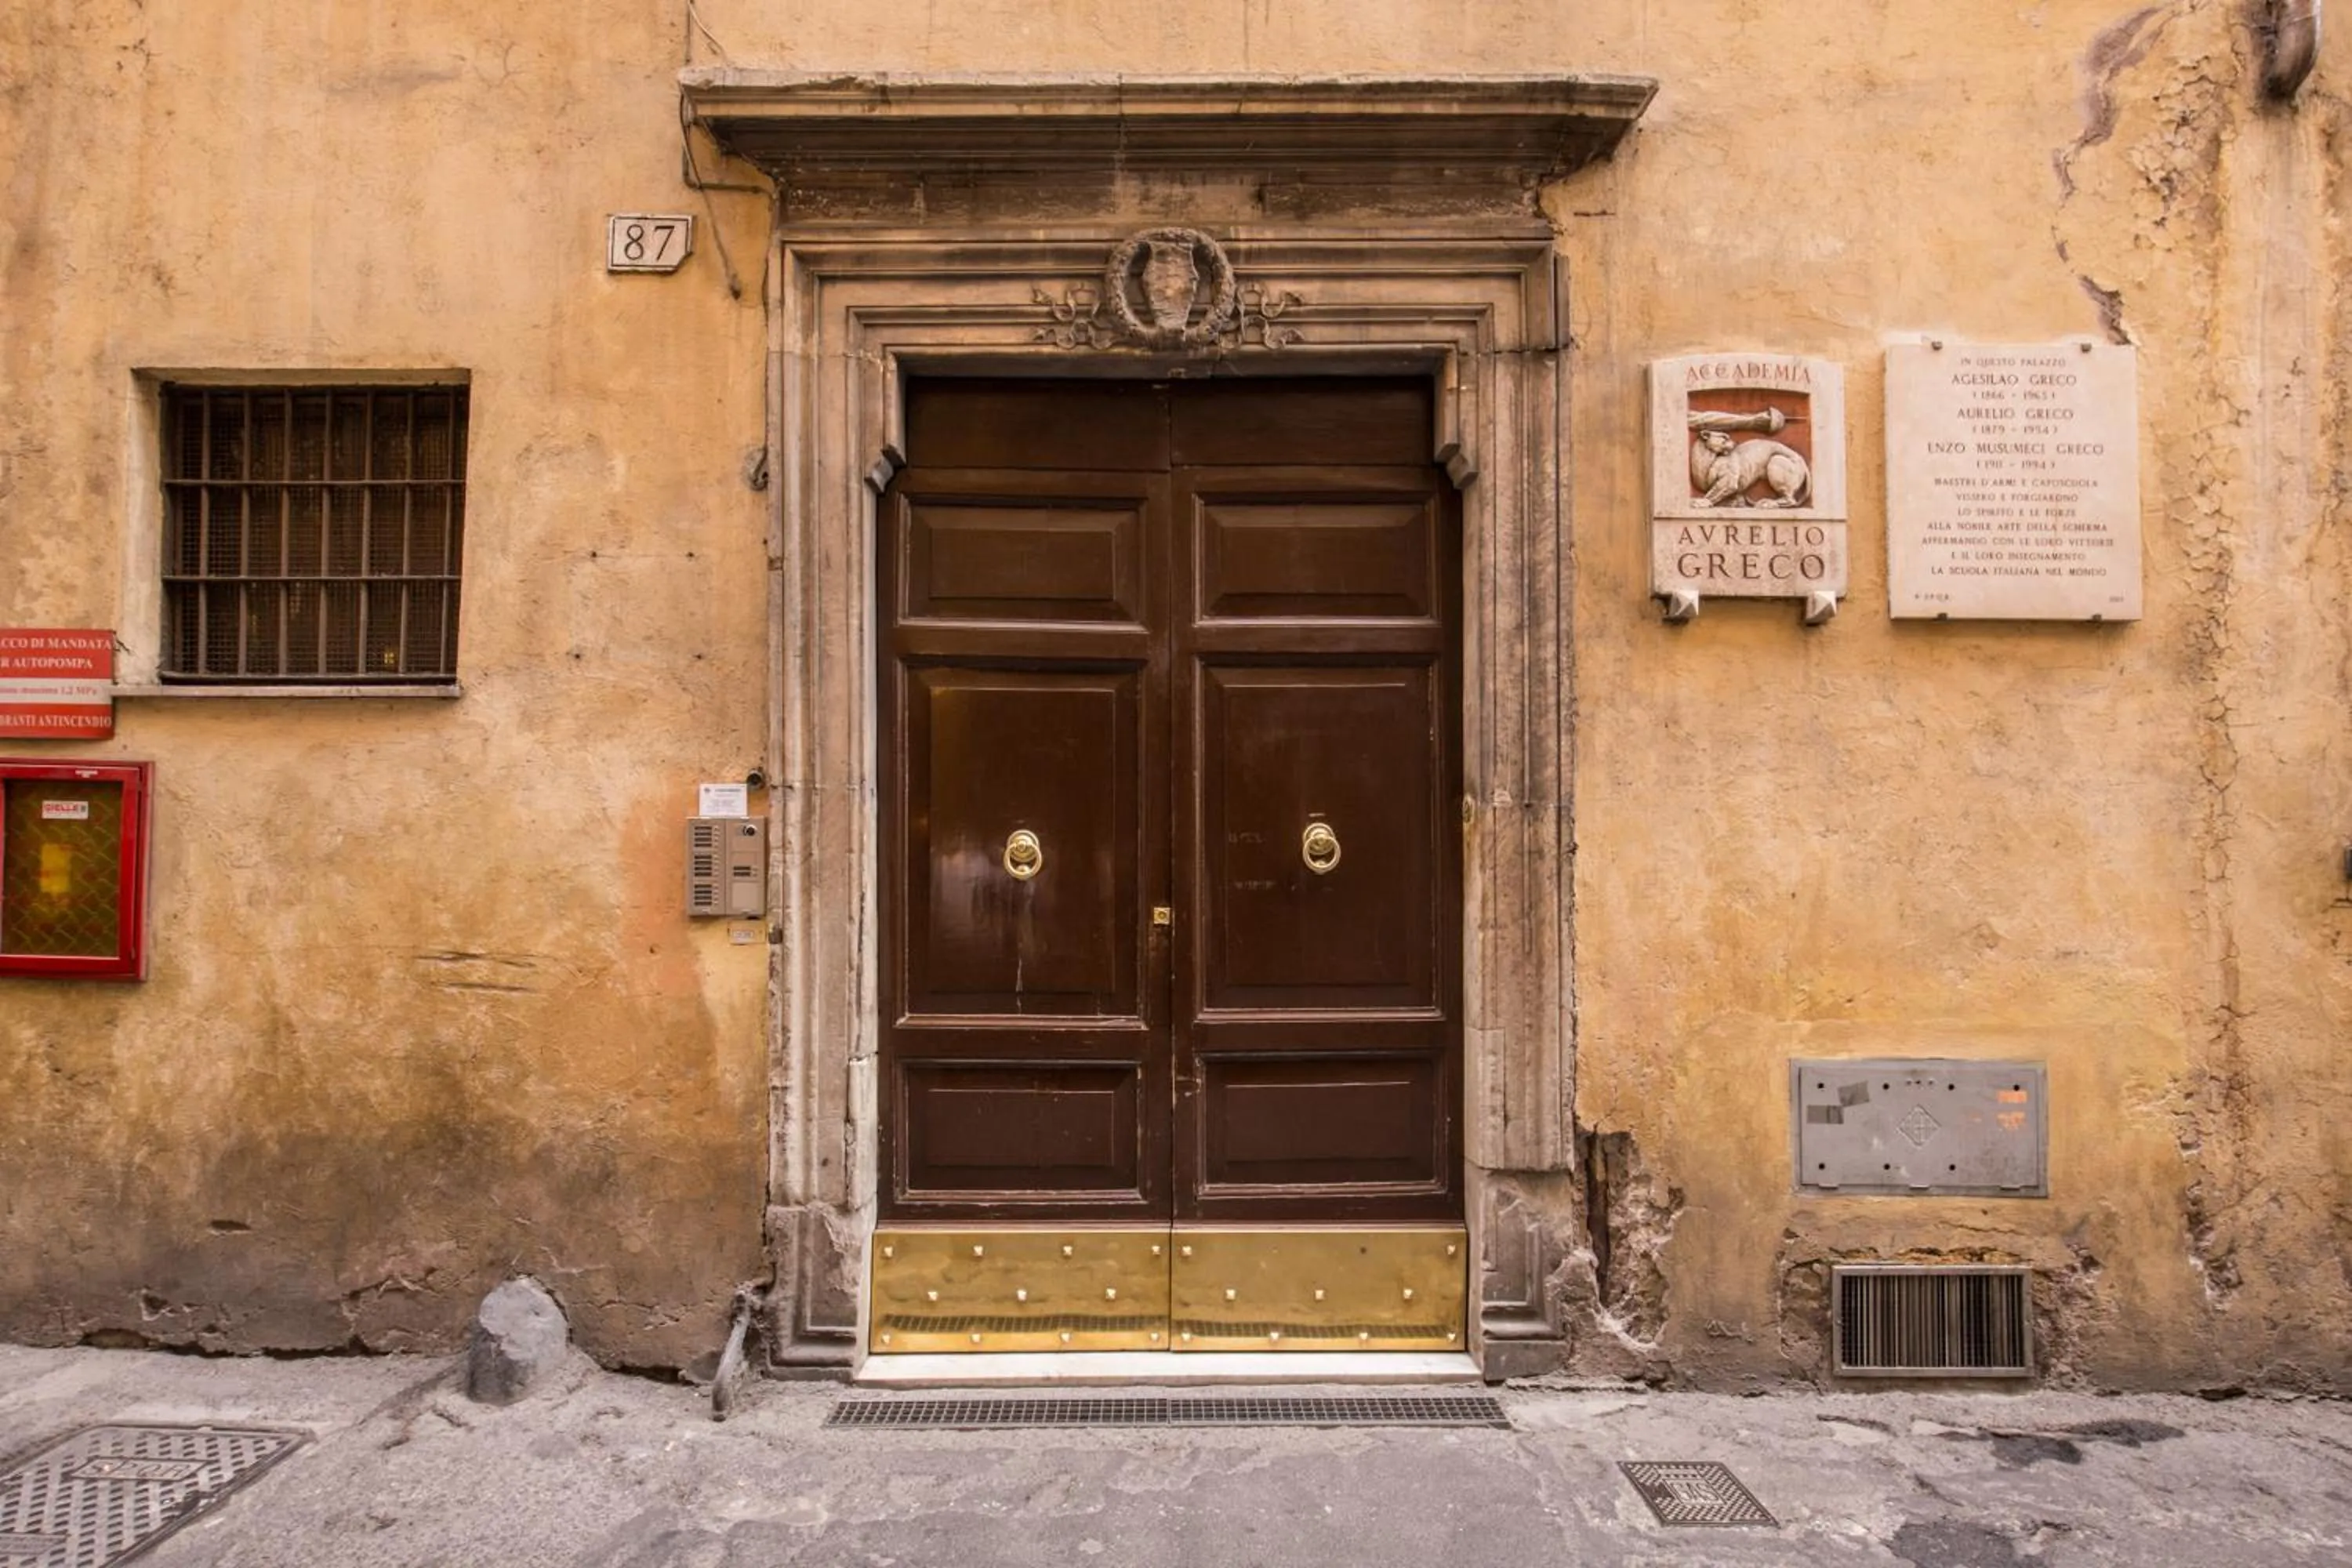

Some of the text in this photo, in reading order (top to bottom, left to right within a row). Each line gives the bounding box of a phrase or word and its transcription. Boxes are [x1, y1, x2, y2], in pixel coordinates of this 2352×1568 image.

[624, 223, 675, 261] 87
[1960, 358, 2067, 368] IN QUESTO PALAZZO
[1686, 363, 1812, 384] ACCADEMIA
[1951, 374, 2078, 386] AGESILAO GRECO
[1957, 407, 2074, 420] AURELIO GRECO
[1927, 442, 2104, 456] ENZO MUSUMECI GRECO
[1934, 478, 1976, 488] MAESTRI
[2021, 479, 2027, 488] E
[2031, 479, 2098, 488] CAPOSCUOLA
[1956, 493, 2078, 503] VISSERO E FORGIARONO
[1958, 508, 2077, 517] LO SPIRITO E LE FORZE
[1927, 522, 2107, 532] ALLA NOBILE ARTE DELLA SCHERMA
[1678, 524, 1825, 547] AVRELIO
[1922, 536, 2114, 547] AFFERMANDO CON LE LORO VITTORIE
[1951, 552, 2086, 561] E IL LORO INSEGNAMENTO
[1676, 552, 1826, 580] GRECO
[1931, 566, 2107, 577] LA SCUOLA ITALIANA NEL MONDO
[31, 637, 45, 649] DI
[47, 637, 111, 650] MANDATA
[13, 657, 93, 669] AUTOPOMPA
[38, 714, 112, 728] ANTINCENDIO
[81, 1459, 191, 1477] SPQR
